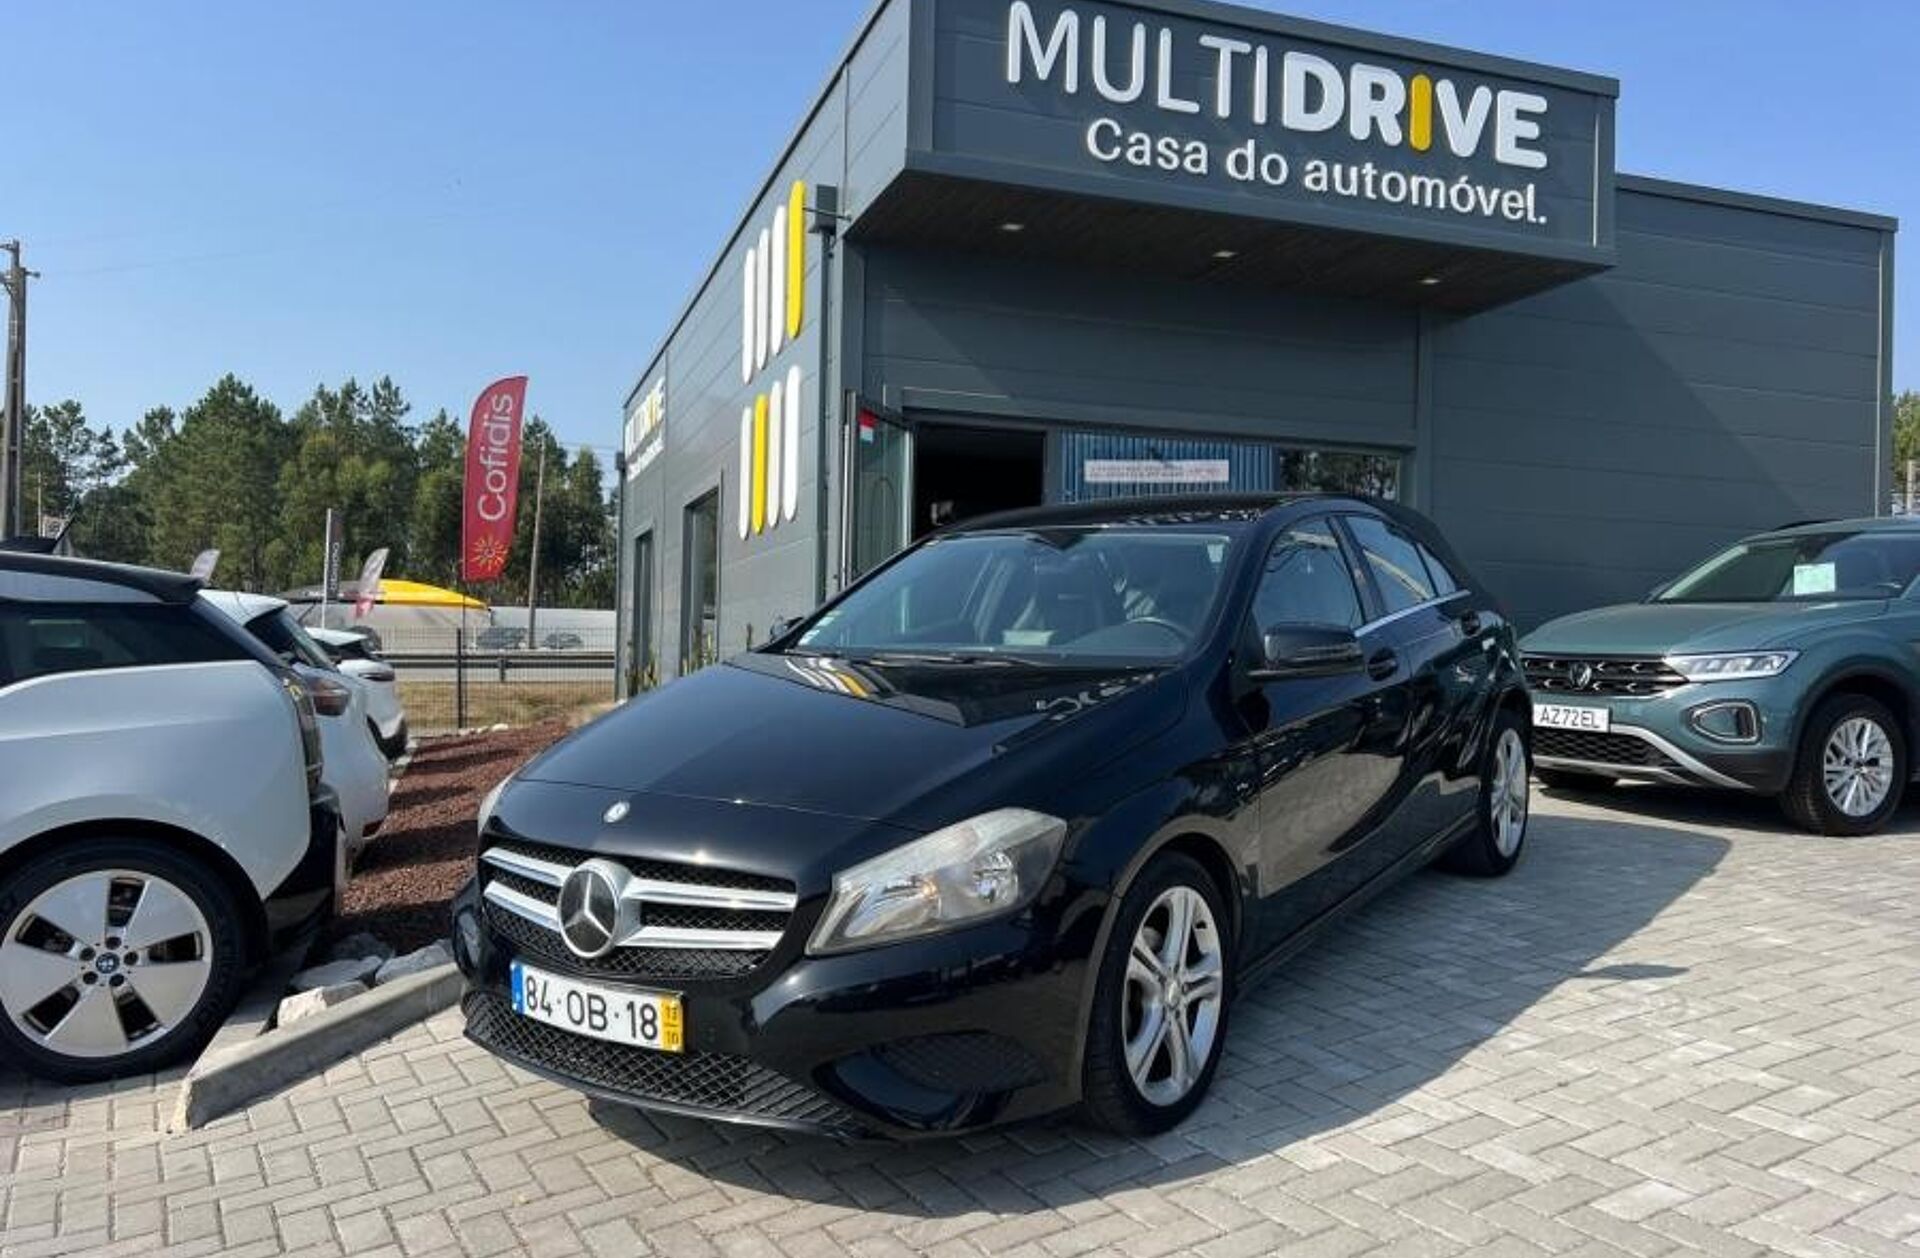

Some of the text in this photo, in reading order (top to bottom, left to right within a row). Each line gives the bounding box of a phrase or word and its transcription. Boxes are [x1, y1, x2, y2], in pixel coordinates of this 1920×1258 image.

[1007, 1, 1548, 168] MULTIDRIVE
[1087, 119, 1547, 224] Casa do automóvel.
[478, 394, 513, 521] Cofidis
[1541, 707, 1599, 728] AZ72EL
